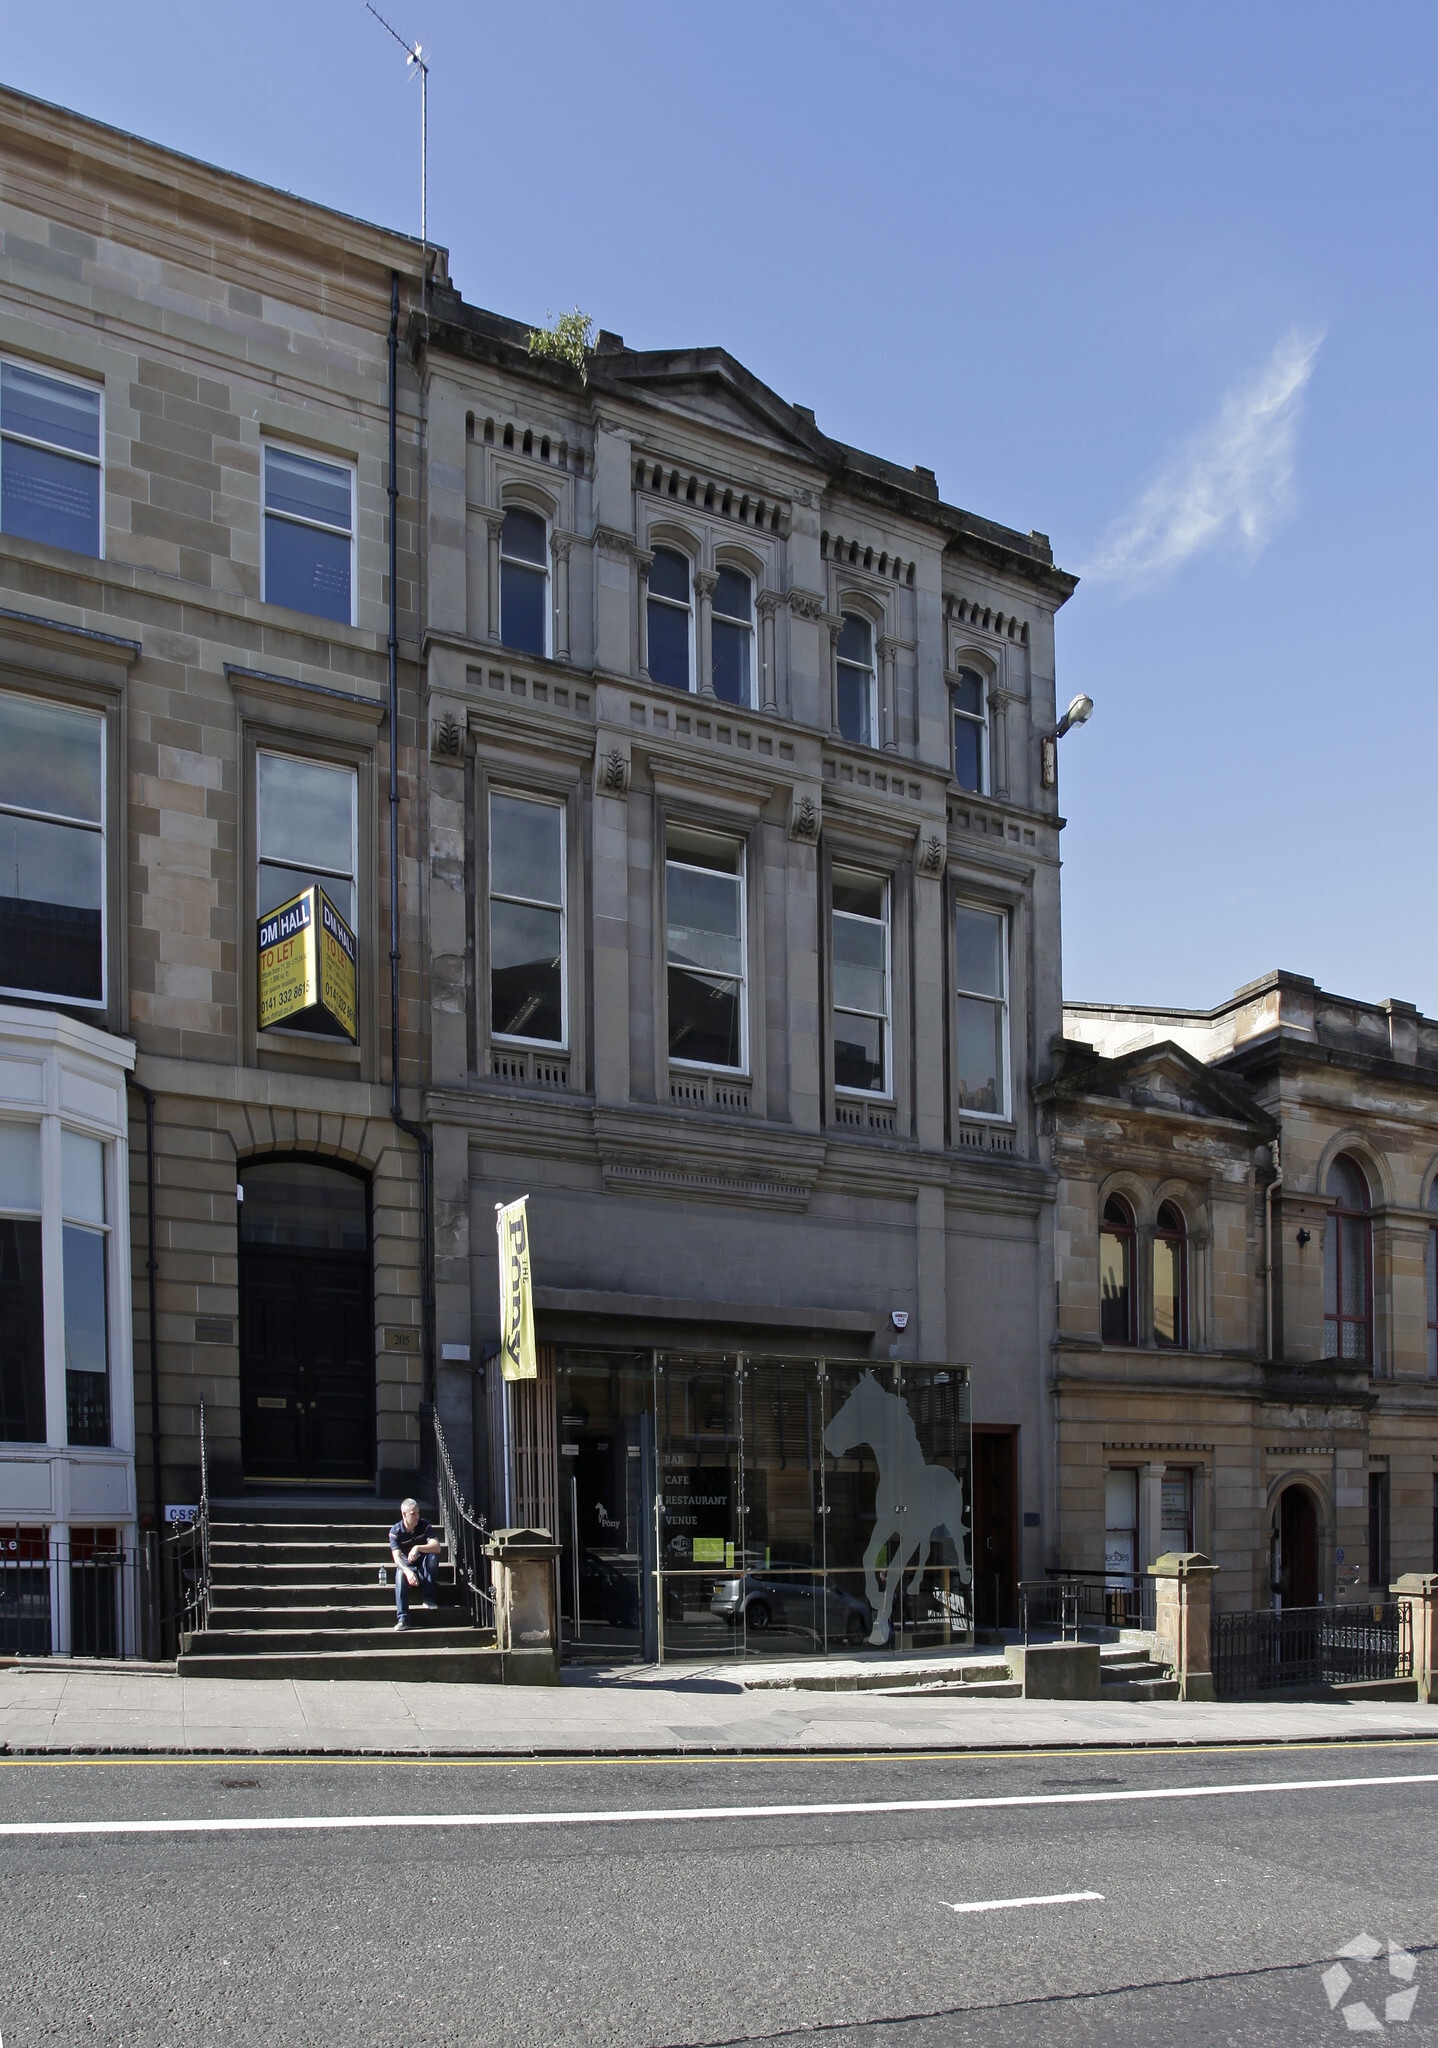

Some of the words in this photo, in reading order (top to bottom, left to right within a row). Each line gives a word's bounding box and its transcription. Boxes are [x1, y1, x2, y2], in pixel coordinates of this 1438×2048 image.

[260, 922, 278, 947] DM
[281, 905, 309, 936] HALL
[324, 906, 337, 935] DM
[338, 927, 355, 961] HALL
[261, 950, 274, 971] TO
[277, 939, 295, 964] LET
[325, 934, 337, 958] TO
[337, 948, 347, 969] LET
[261, 996, 277, 1014] 0141
[278, 989, 293, 1006] 332
[293, 980, 310, 999] 8615
[394, 1334, 410, 1346] 205
[665, 1455, 684, 1465] BAR
[665, 1475, 689, 1485] CAFE
[665, 1495, 727, 1505] RESTAURANT
[665, 1516, 698, 1525] VENUE
